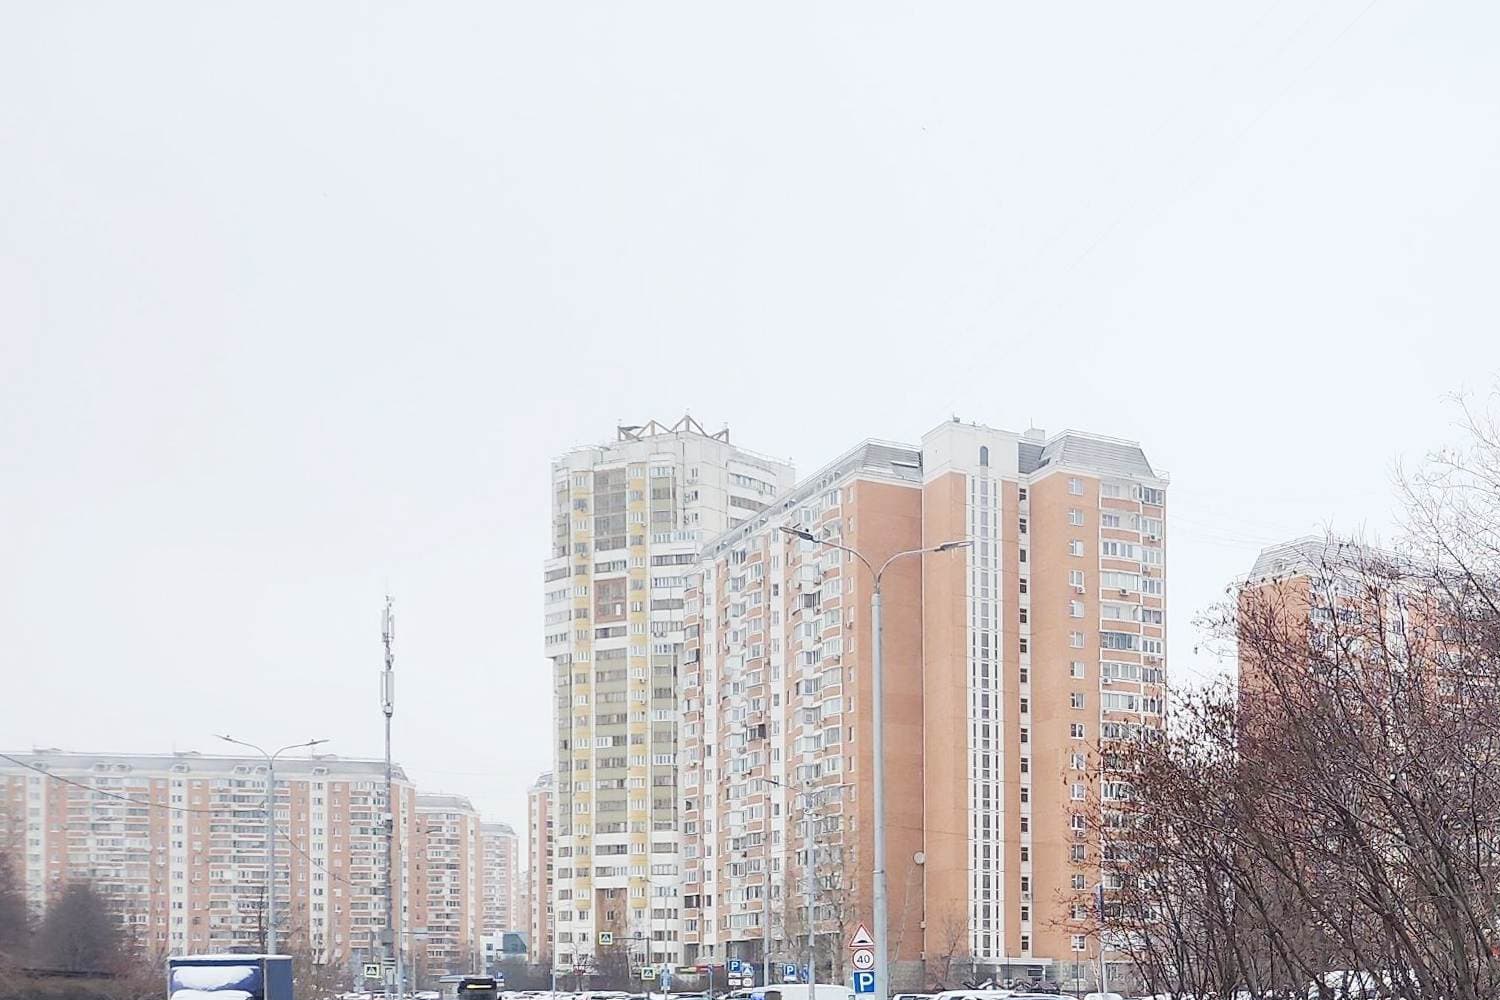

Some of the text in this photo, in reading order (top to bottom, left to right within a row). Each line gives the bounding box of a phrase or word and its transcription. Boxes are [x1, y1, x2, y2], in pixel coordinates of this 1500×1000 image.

[856, 954, 871, 964] 40
[731, 961, 739, 971] P
[786, 965, 794, 976] P
[860, 973, 873, 992] P
